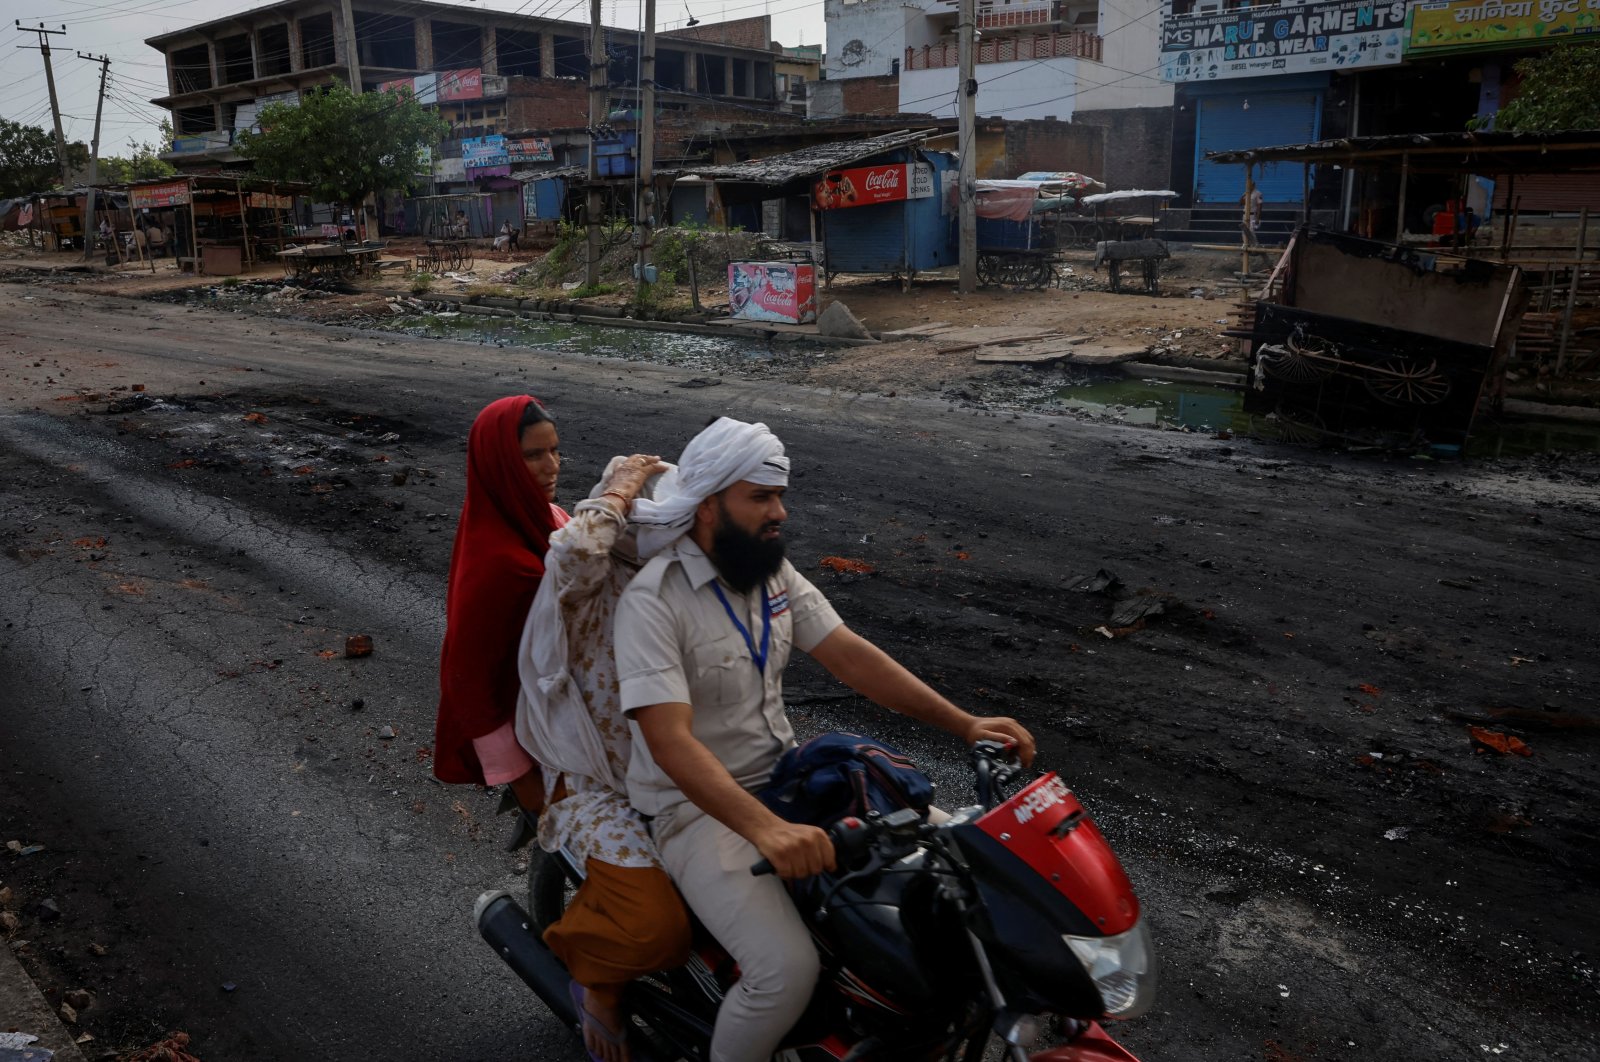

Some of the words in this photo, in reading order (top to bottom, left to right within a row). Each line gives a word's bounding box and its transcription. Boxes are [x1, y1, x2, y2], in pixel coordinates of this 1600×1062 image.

[1454, 0, 1533, 22] सानिया
[1194, 20, 1266, 47] MARUF
[1273, 3, 1404, 39] GARMENTS
[1225, 45, 1236, 59] &
[1238, 41, 1276, 58] KIDS
[1280, 36, 1327, 54] WEAR
[866, 169, 900, 191] Coca-Cola
